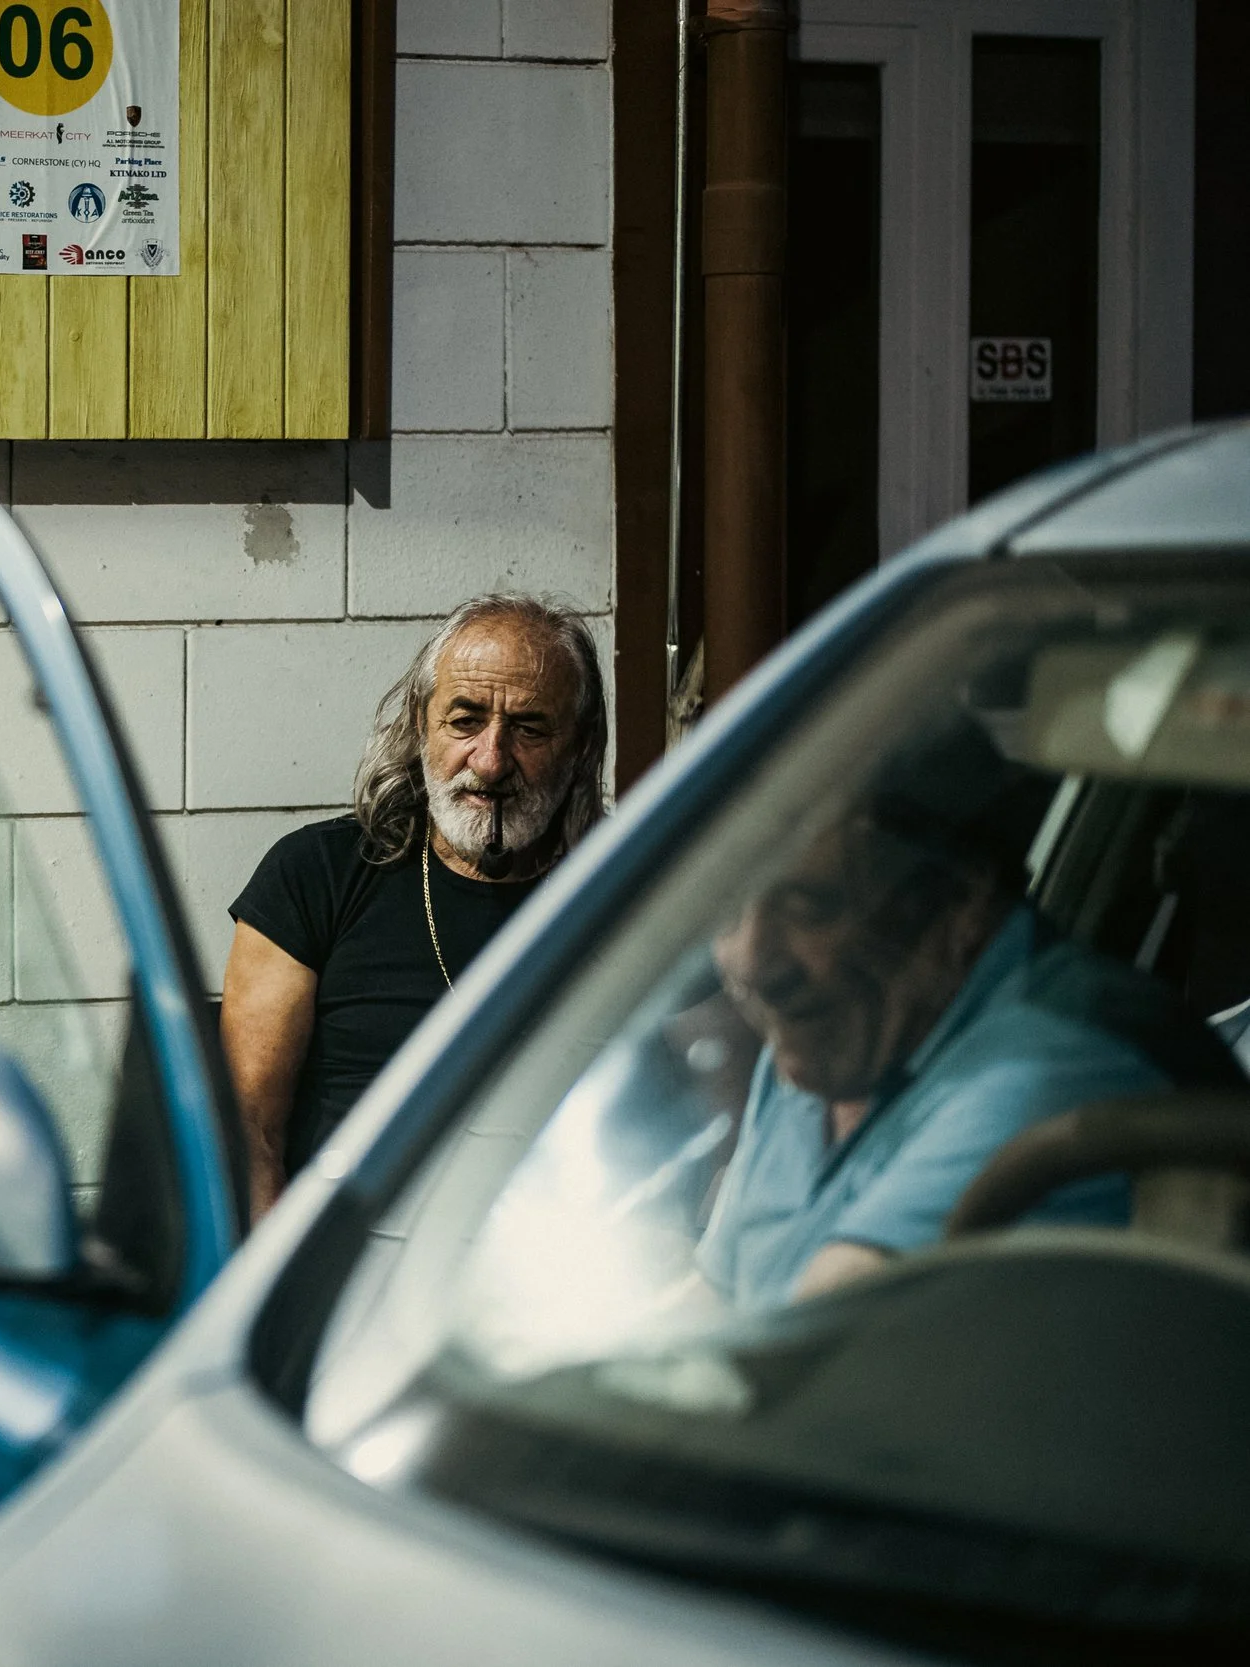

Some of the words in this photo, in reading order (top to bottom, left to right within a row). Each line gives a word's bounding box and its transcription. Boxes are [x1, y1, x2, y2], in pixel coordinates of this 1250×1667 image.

[0, 130, 55, 139] MEERKAT
[65, 132, 91, 140] CITY
[12, 157, 69, 167] CORNERSTONE
[71, 159, 86, 168] (CY)
[88, 160, 101, 168] HQ
[115, 158, 143, 166] Parking
[151, 170, 167, 178] LTD
[977, 342, 1047, 380] SBS
